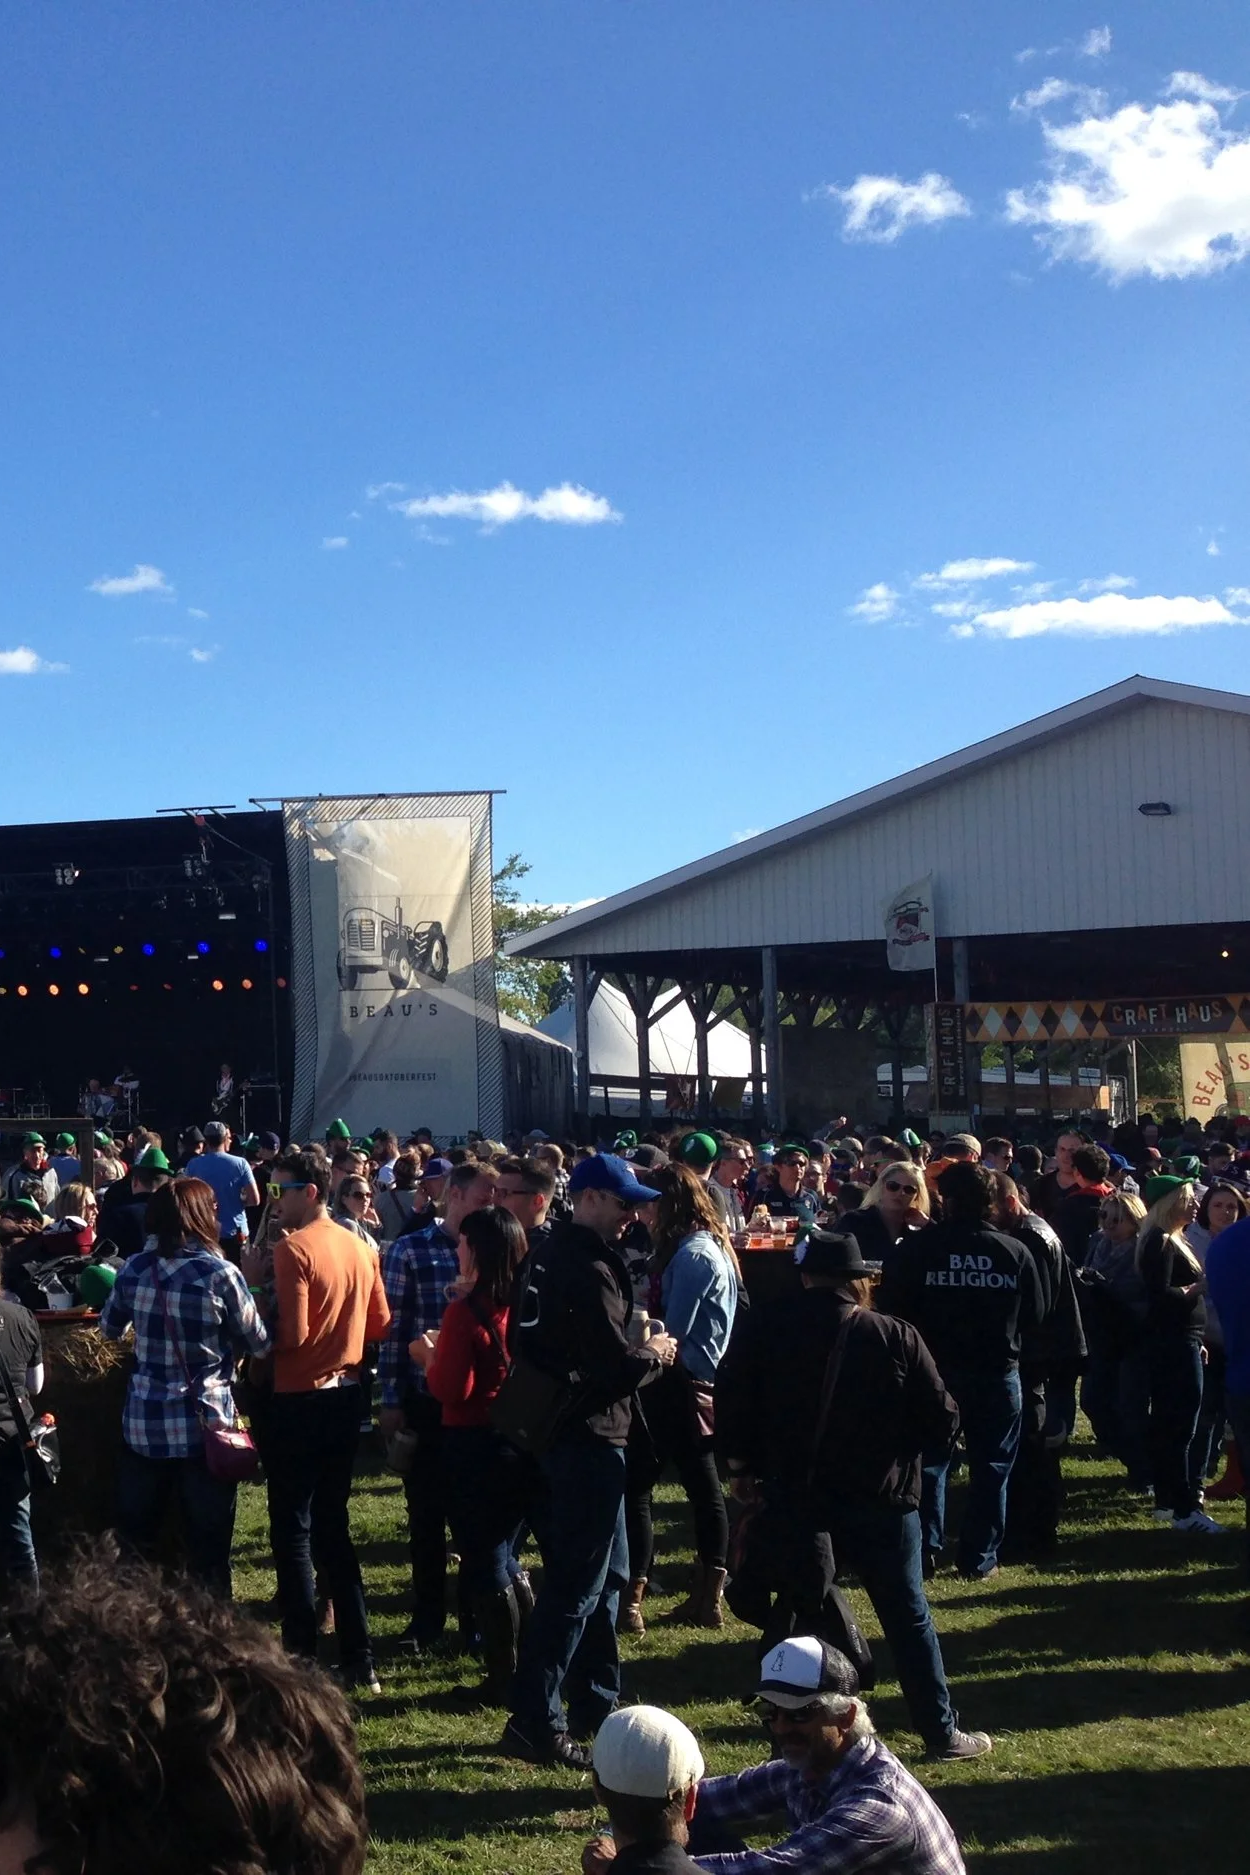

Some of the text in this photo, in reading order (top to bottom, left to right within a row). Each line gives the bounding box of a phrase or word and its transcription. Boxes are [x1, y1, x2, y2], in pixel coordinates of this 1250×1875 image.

[349, 1003, 438, 1018] BEAU'S
[1112, 1001, 1223, 1025] CRAFT HAUS
[938, 1008, 954, 1045] HAUS
[1192, 1053, 1250, 1107] BEAU'S
[949, 1253, 993, 1270] BAD
[924, 1270, 1018, 1289] RELIGION
